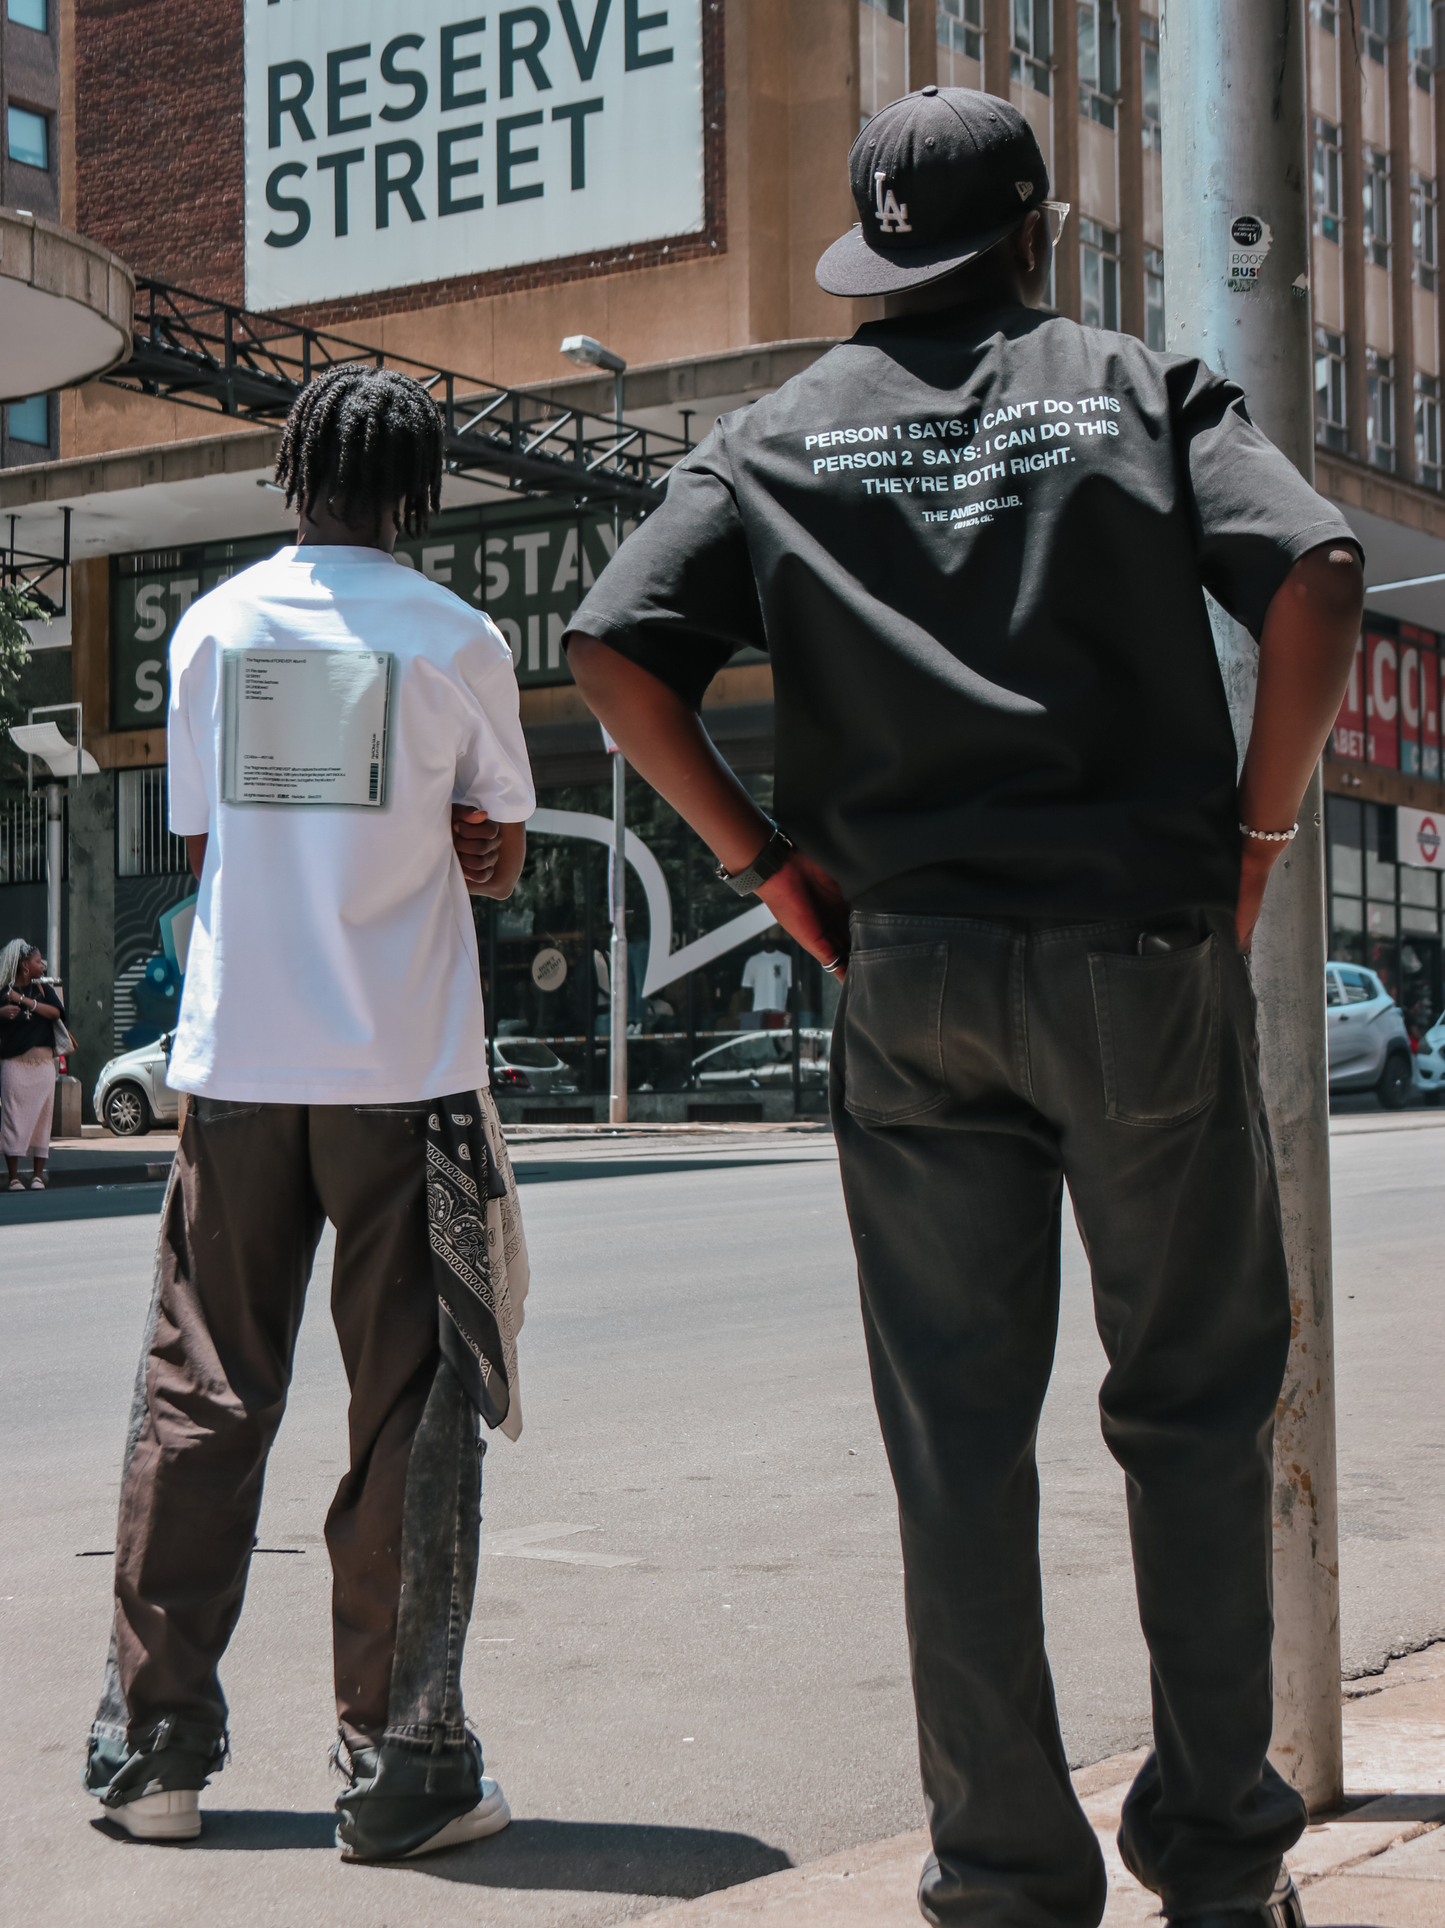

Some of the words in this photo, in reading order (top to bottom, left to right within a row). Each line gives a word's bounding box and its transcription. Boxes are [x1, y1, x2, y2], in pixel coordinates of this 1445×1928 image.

[267, 0, 675, 149] RESERVE
[263, 97, 605, 248] STREET
[874, 171, 913, 233] LA
[805, 425, 888, 451] PERSON
[894, 425, 902, 440] 1
[908, 419, 969, 440] SAYS:
[974, 418, 980, 434] I
[982, 400, 1039, 430] CAN'T
[1043, 399, 1074, 414] DO
[1077, 396, 1121, 415] THIS
[813, 450, 897, 475] PERSON
[901, 450, 914, 466] 2
[922, 445, 981, 466] SAYS:
[985, 439, 992, 456] I
[993, 426, 1036, 452] CAN
[1040, 421, 1072, 440] DO
[1074, 420, 1120, 437] THIS
[861, 475, 949, 495] THEY'RE
[952, 463, 1005, 490] BOTH
[1010, 446, 1076, 475] RIGHT.
[922, 510, 949, 522] THE
[950, 500, 985, 520] AMEN
[985, 495, 1023, 511] CLUB.
